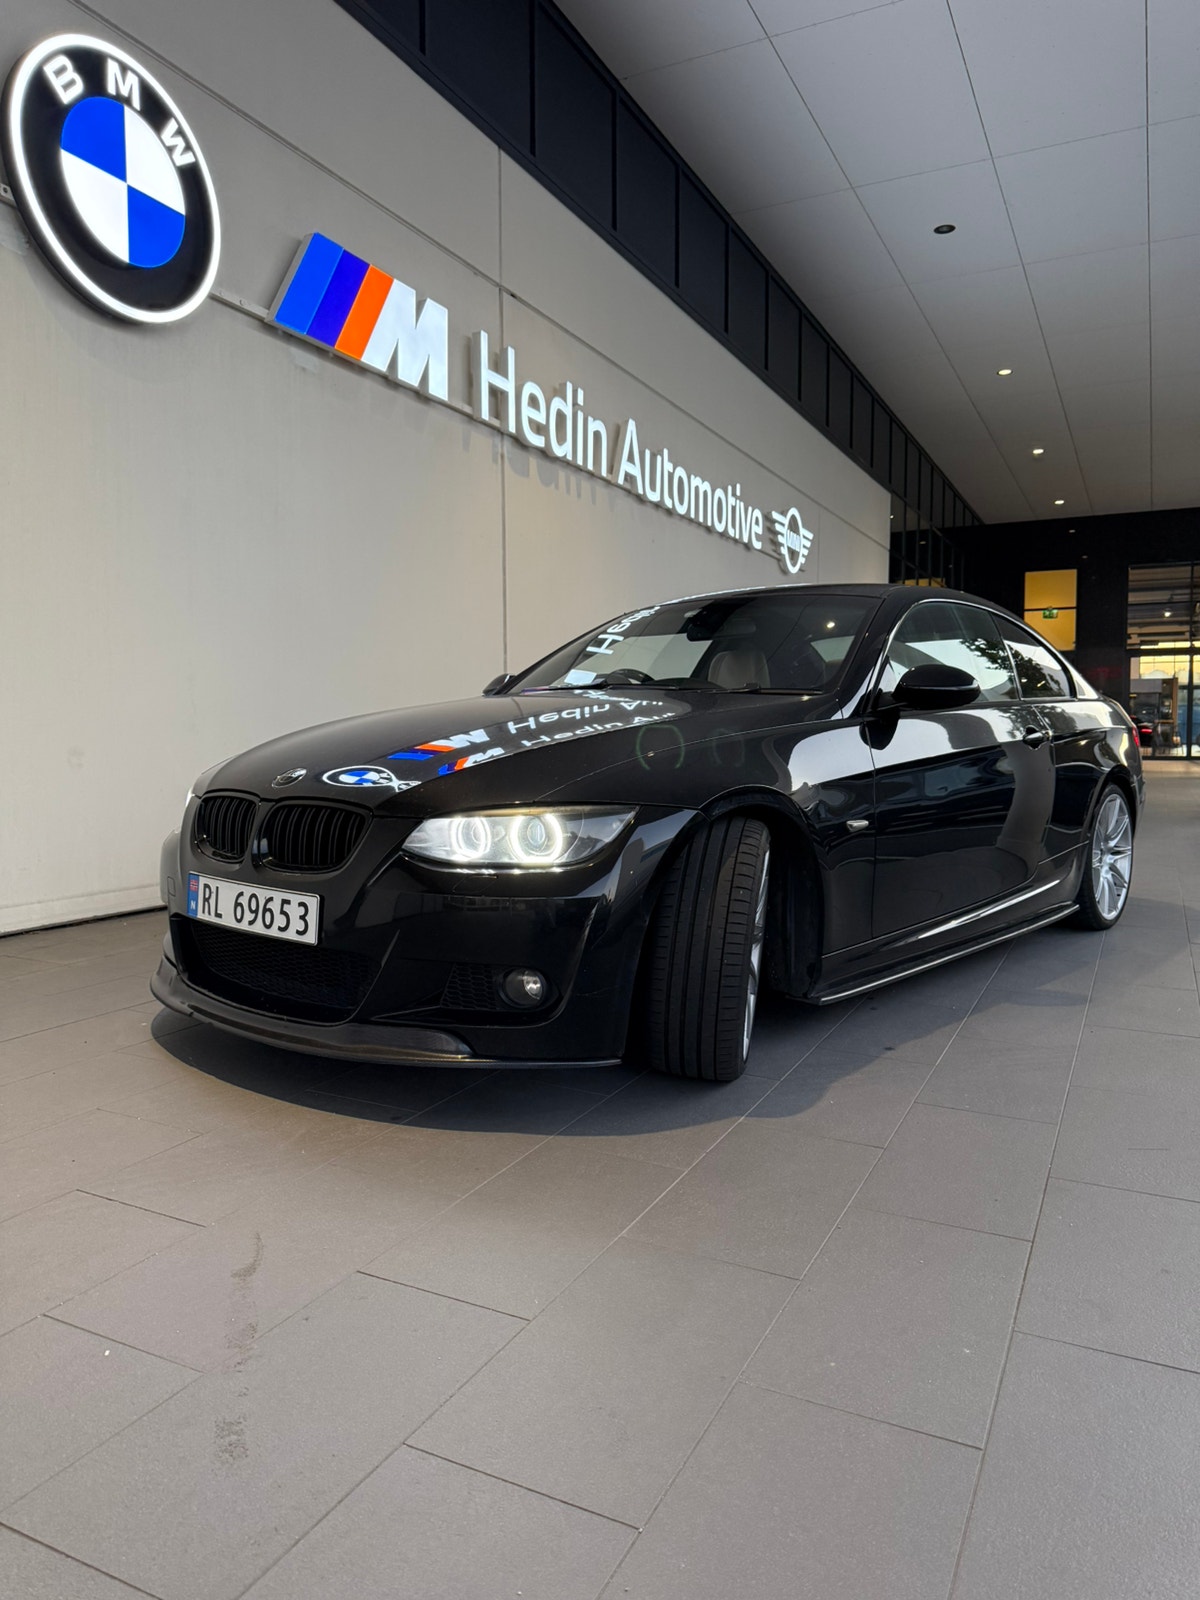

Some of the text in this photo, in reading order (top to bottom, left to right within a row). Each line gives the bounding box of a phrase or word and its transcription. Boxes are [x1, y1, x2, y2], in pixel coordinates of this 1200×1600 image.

[43, 54, 196, 168] BMW
[360, 278, 448, 401] M
[479, 329, 764, 550] Hedin Automotive
[190, 900, 196, 910] N
[202, 883, 309, 936] RL 69653
